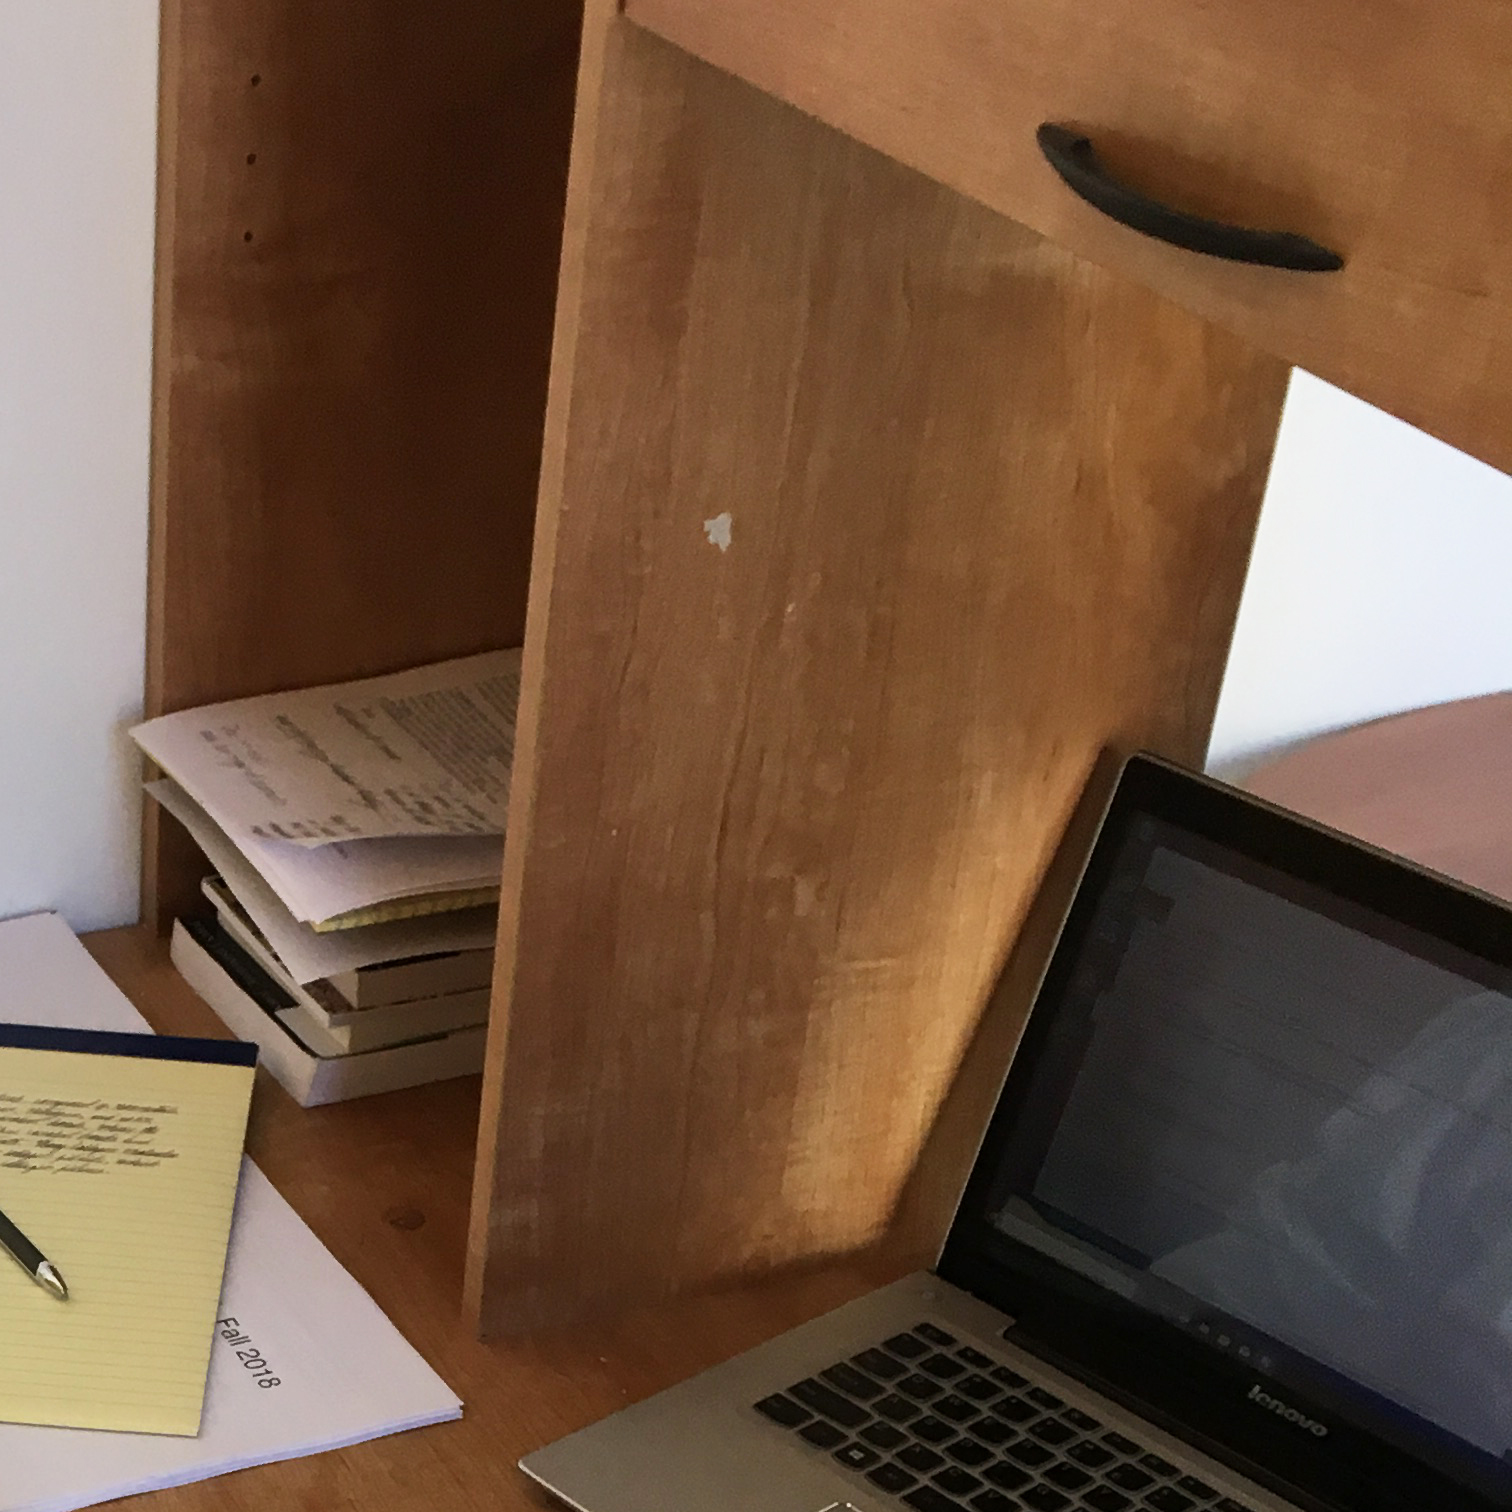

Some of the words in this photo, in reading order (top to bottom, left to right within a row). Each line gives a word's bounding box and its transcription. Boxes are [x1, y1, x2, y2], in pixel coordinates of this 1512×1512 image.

[216, 1316, 252, 1347] Fall
[235, 1348, 282, 1389] 2018
[1248, 1384, 1328, 1436] lenovo
